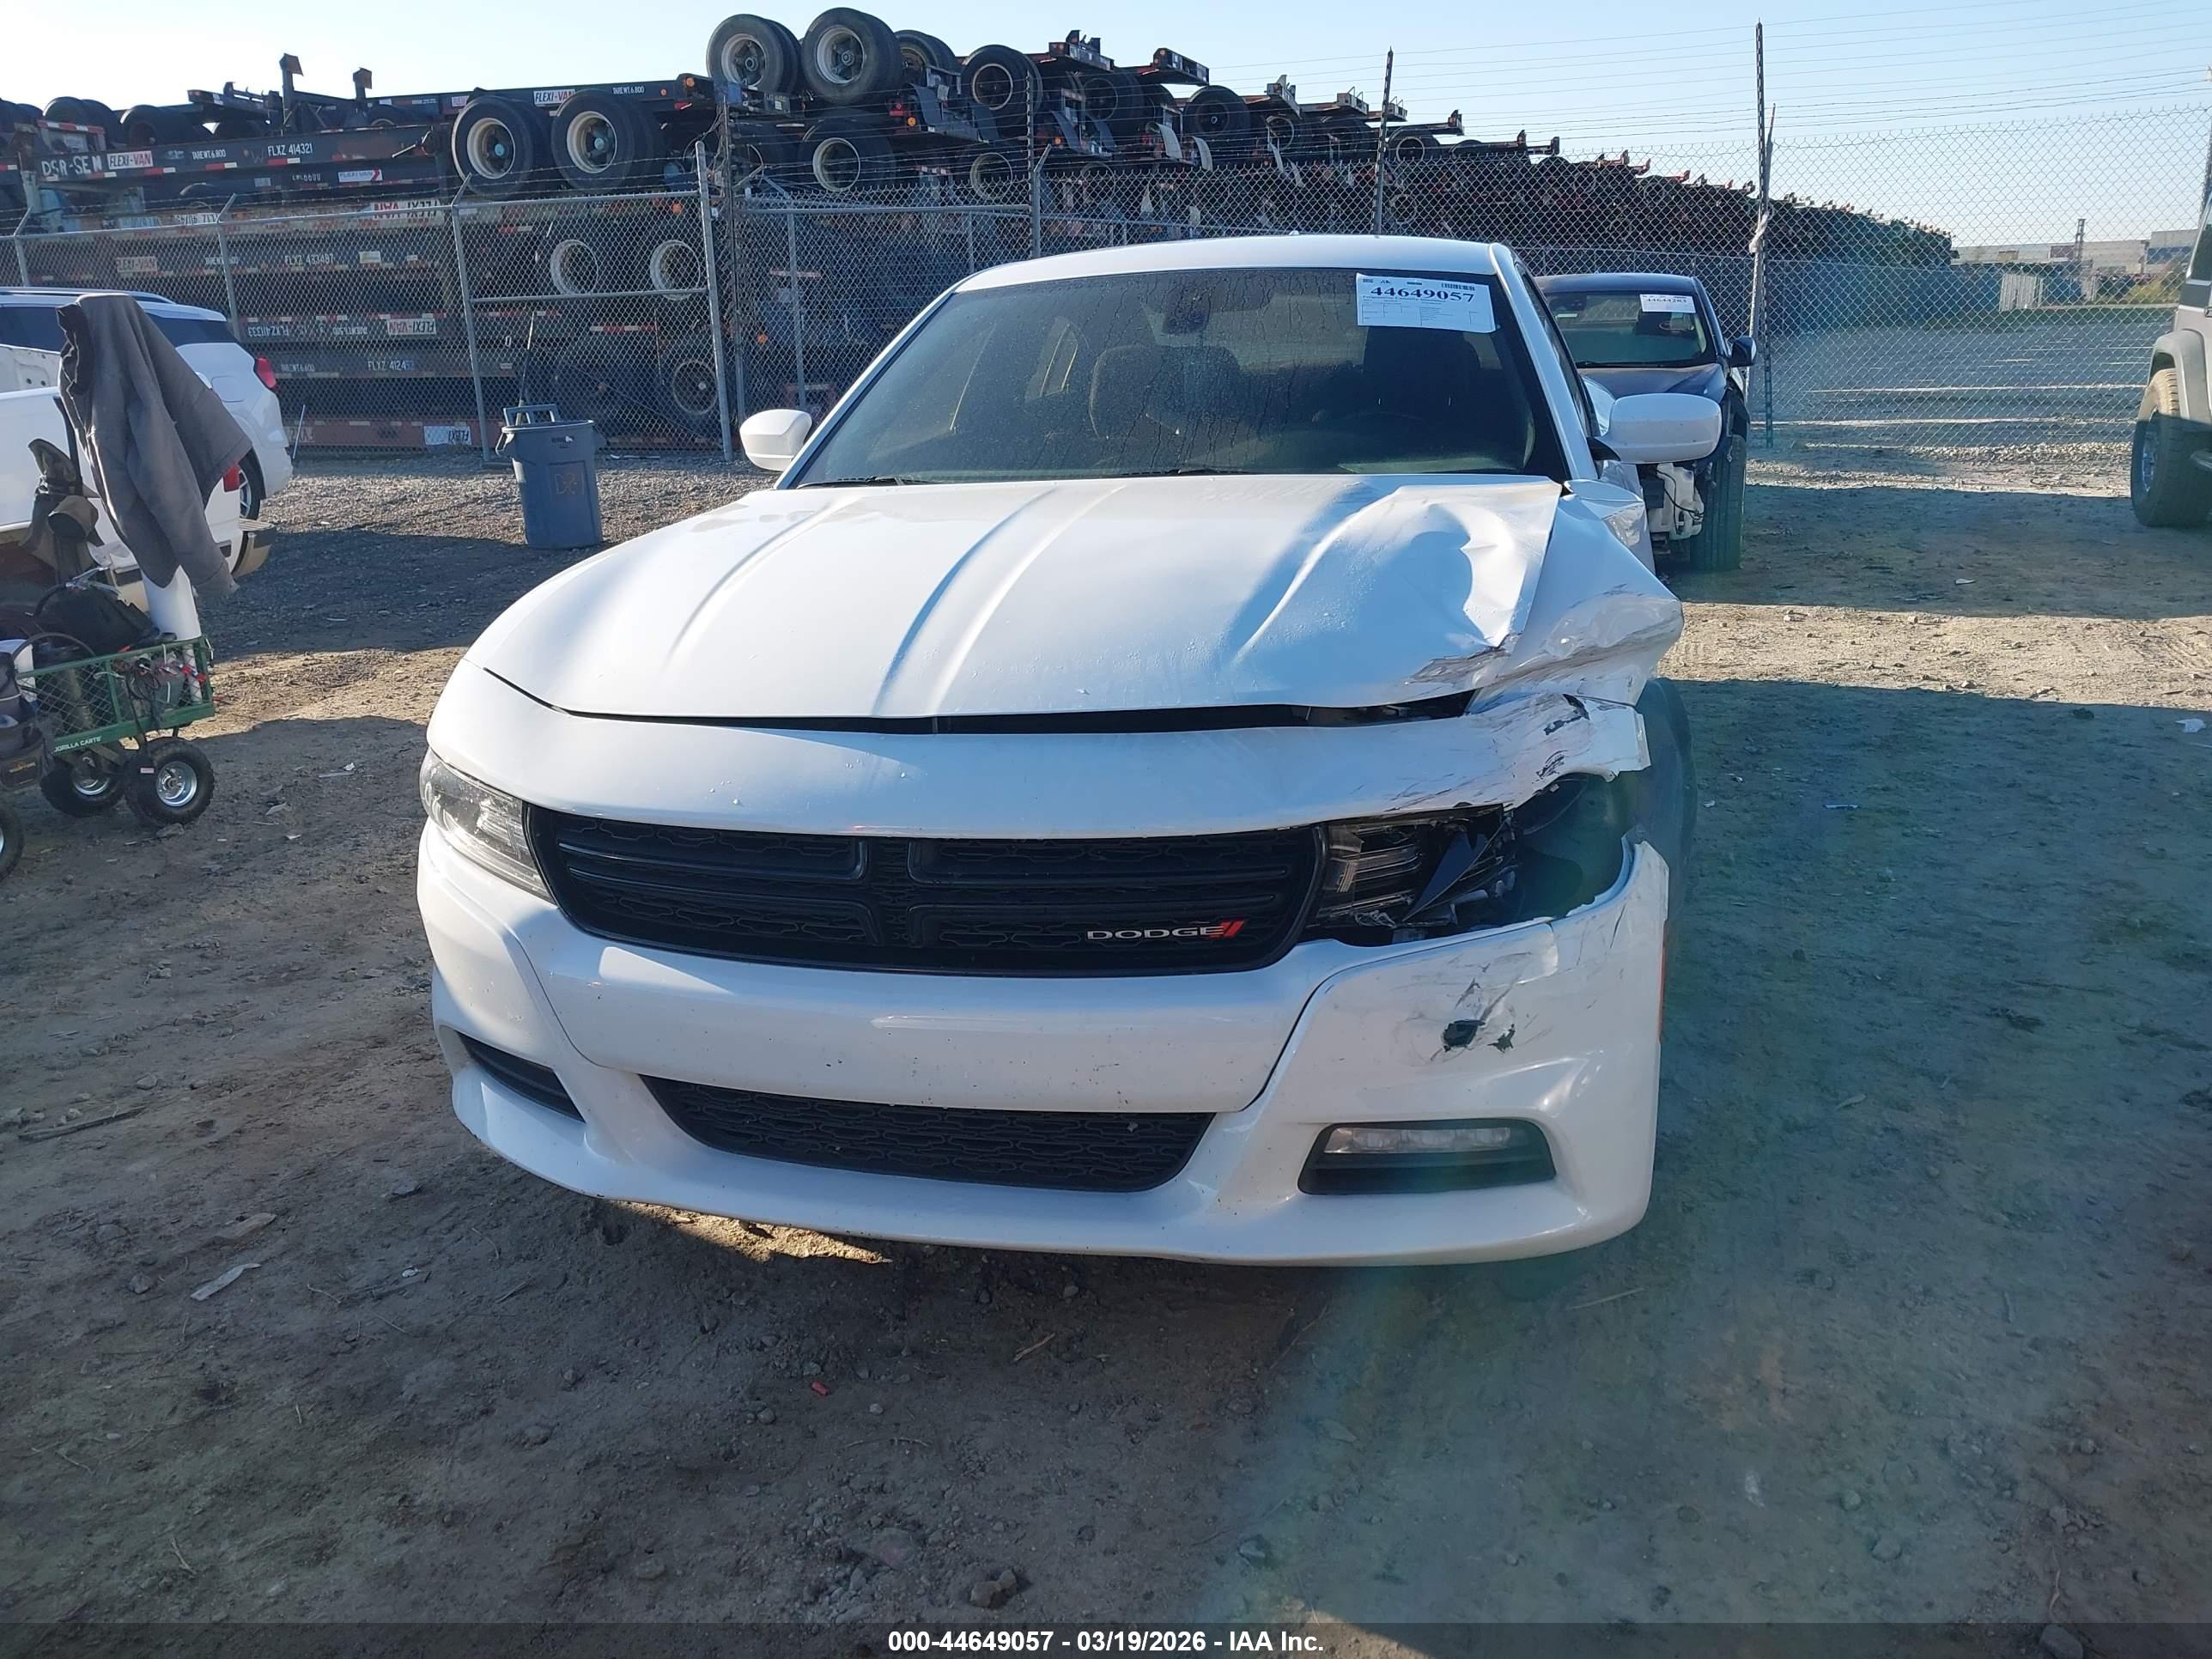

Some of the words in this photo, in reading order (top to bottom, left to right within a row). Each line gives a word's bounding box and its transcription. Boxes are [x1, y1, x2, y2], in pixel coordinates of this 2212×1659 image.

[267, 144, 286, 156] FLXZ
[289, 143, 313, 155] 414321
[109, 153, 151, 168] FLEXI-VAN
[1370, 286, 1474, 303] 44649057
[1087, 926, 1224, 939] DODGE
